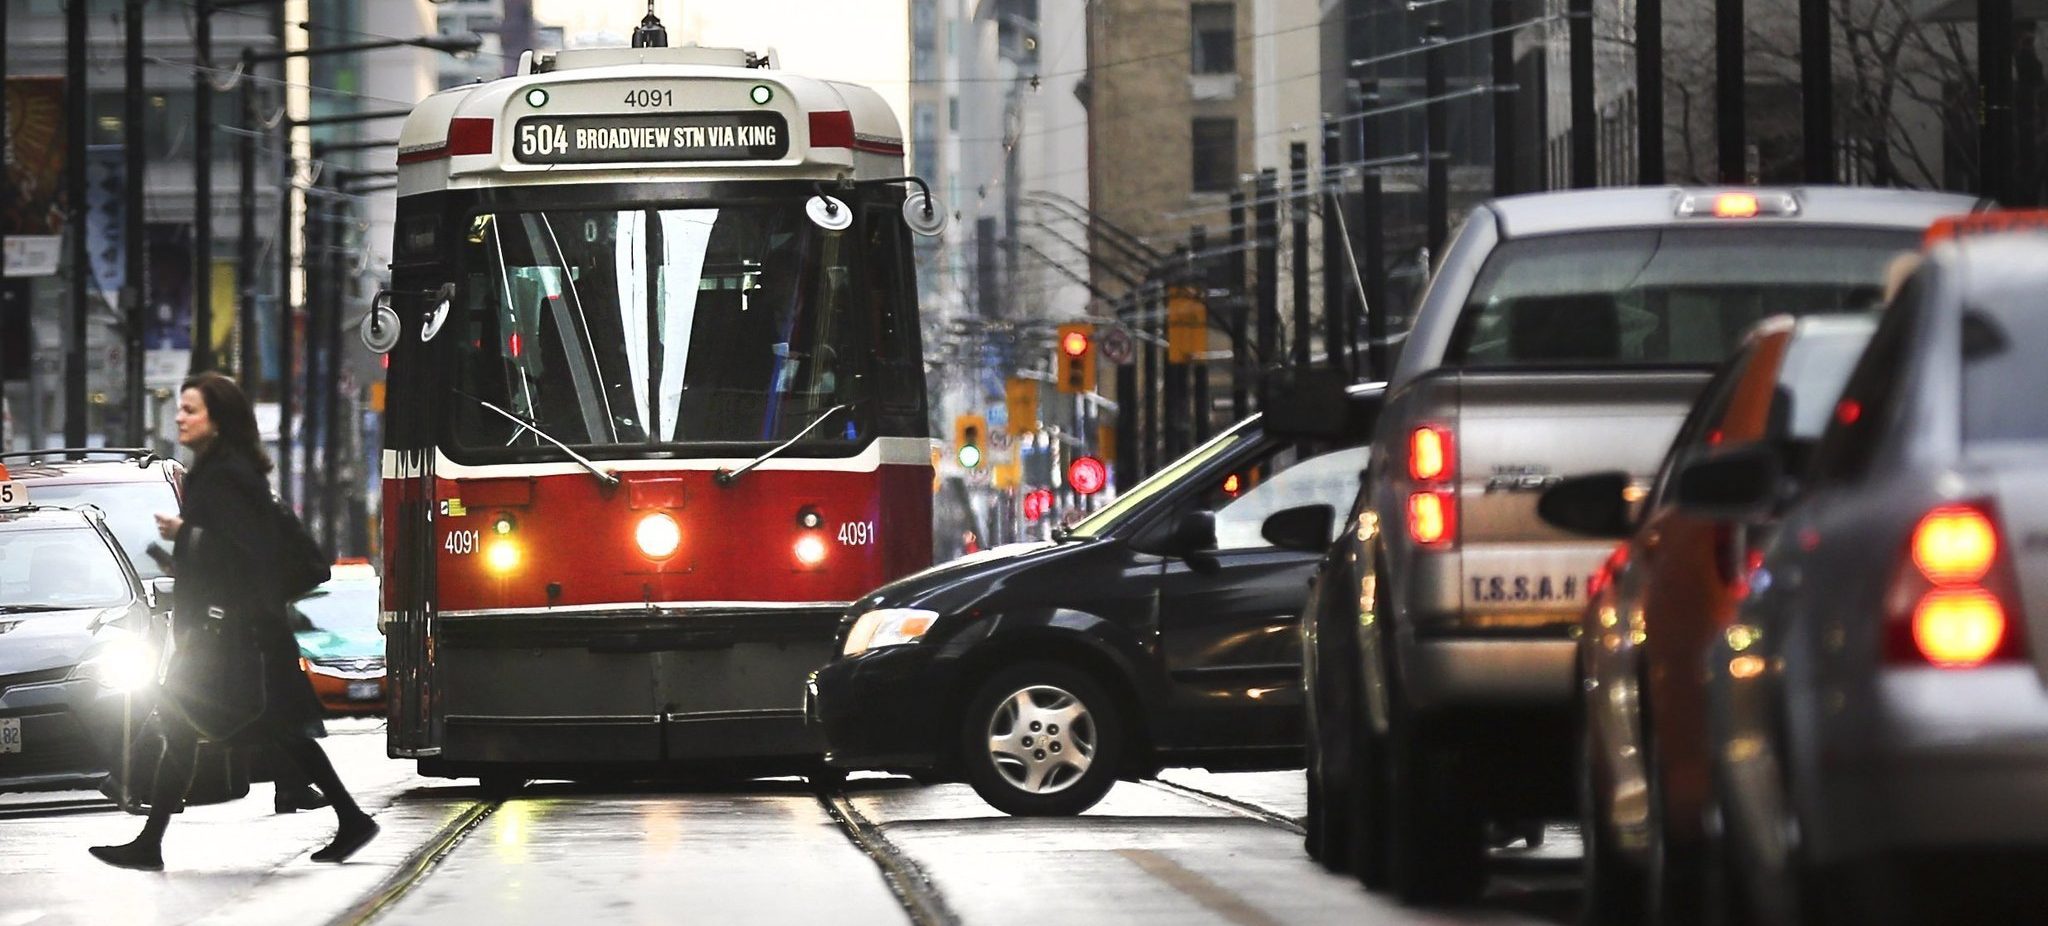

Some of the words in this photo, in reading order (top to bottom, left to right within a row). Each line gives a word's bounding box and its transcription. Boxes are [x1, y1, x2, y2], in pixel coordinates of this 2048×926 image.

[623, 89, 673, 107] 4091
[521, 124, 569, 155] 504
[576, 127, 671, 149] BROADVIEW
[673, 126, 705, 148] STN
[707, 126, 735, 147] VIA
[737, 125, 776, 146] KING
[0, 484, 13, 503] 5
[445, 529, 479, 554] 4091
[837, 521, 874, 545] 4091
[0, 727, 20, 745] 82
